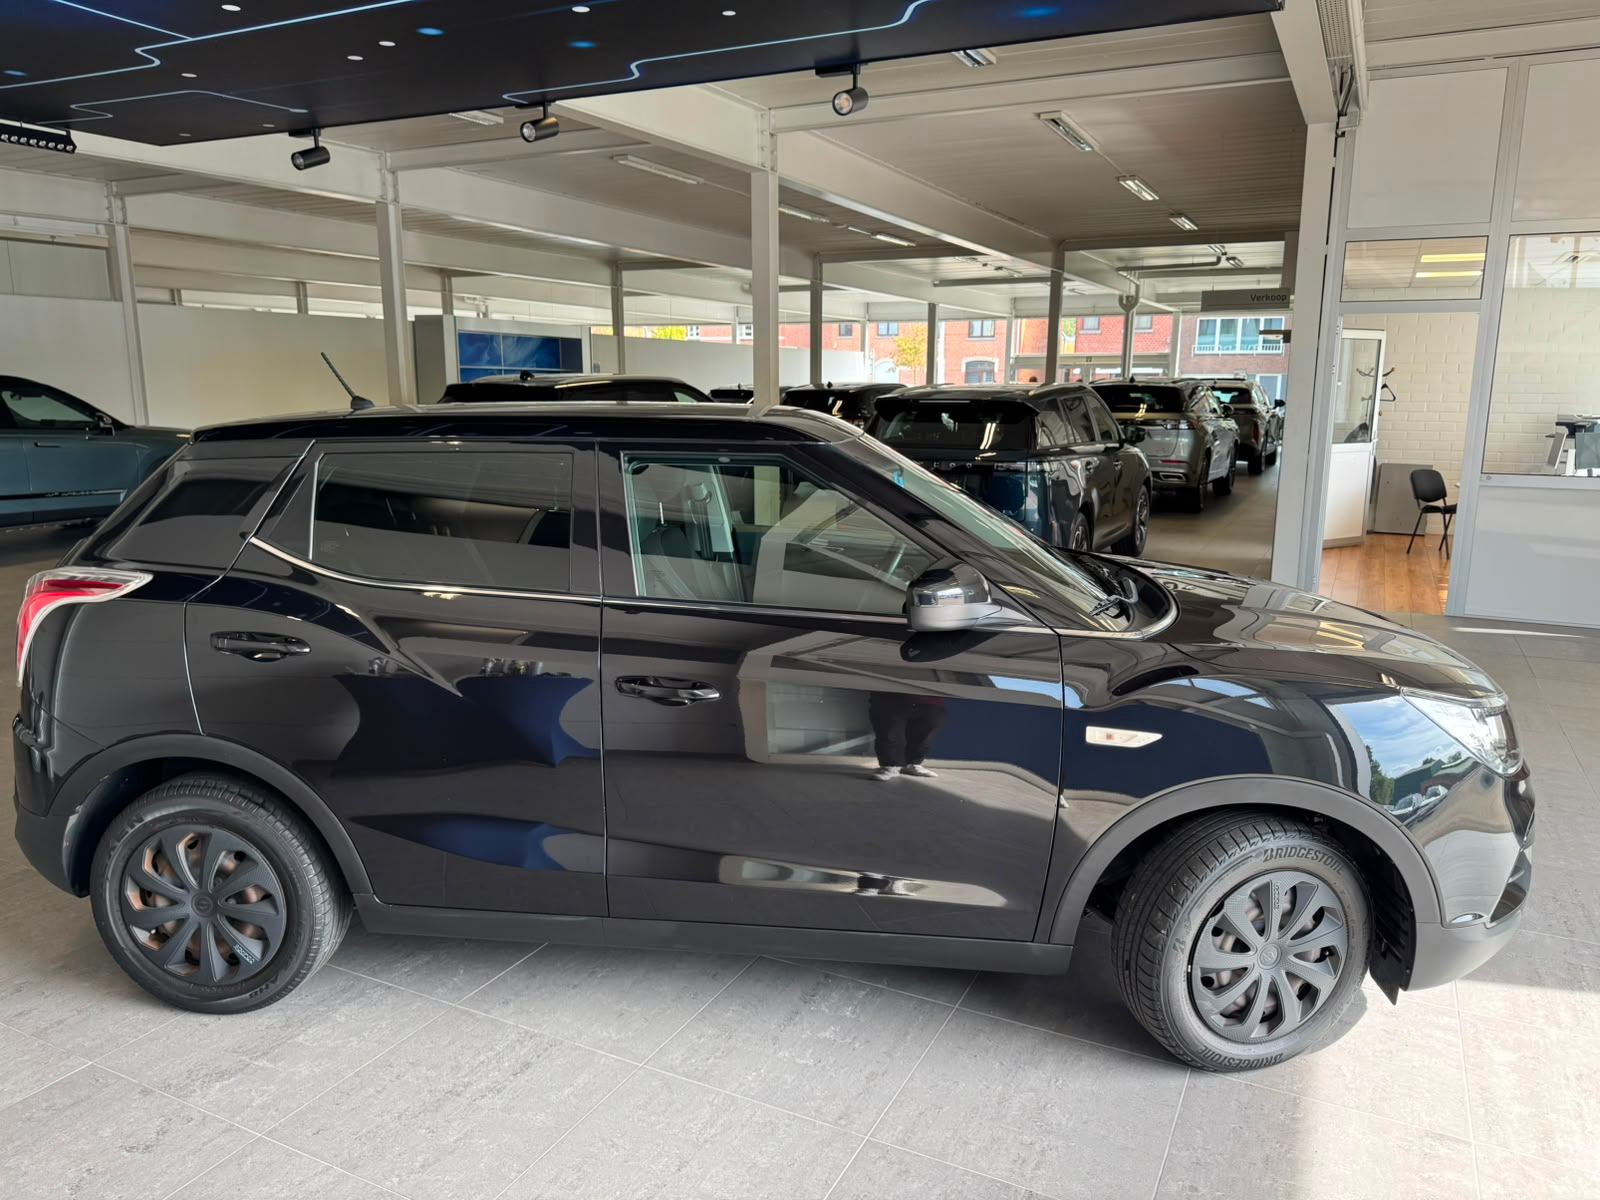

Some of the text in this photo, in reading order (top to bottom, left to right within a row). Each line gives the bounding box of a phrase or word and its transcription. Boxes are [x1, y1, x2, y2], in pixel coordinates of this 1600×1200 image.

[1250, 293, 1287, 302] Verkoop
[1262, 846, 1345, 875] BRIDGESTONE
[1199, 1045, 1284, 1070] BRIDGESTONE
